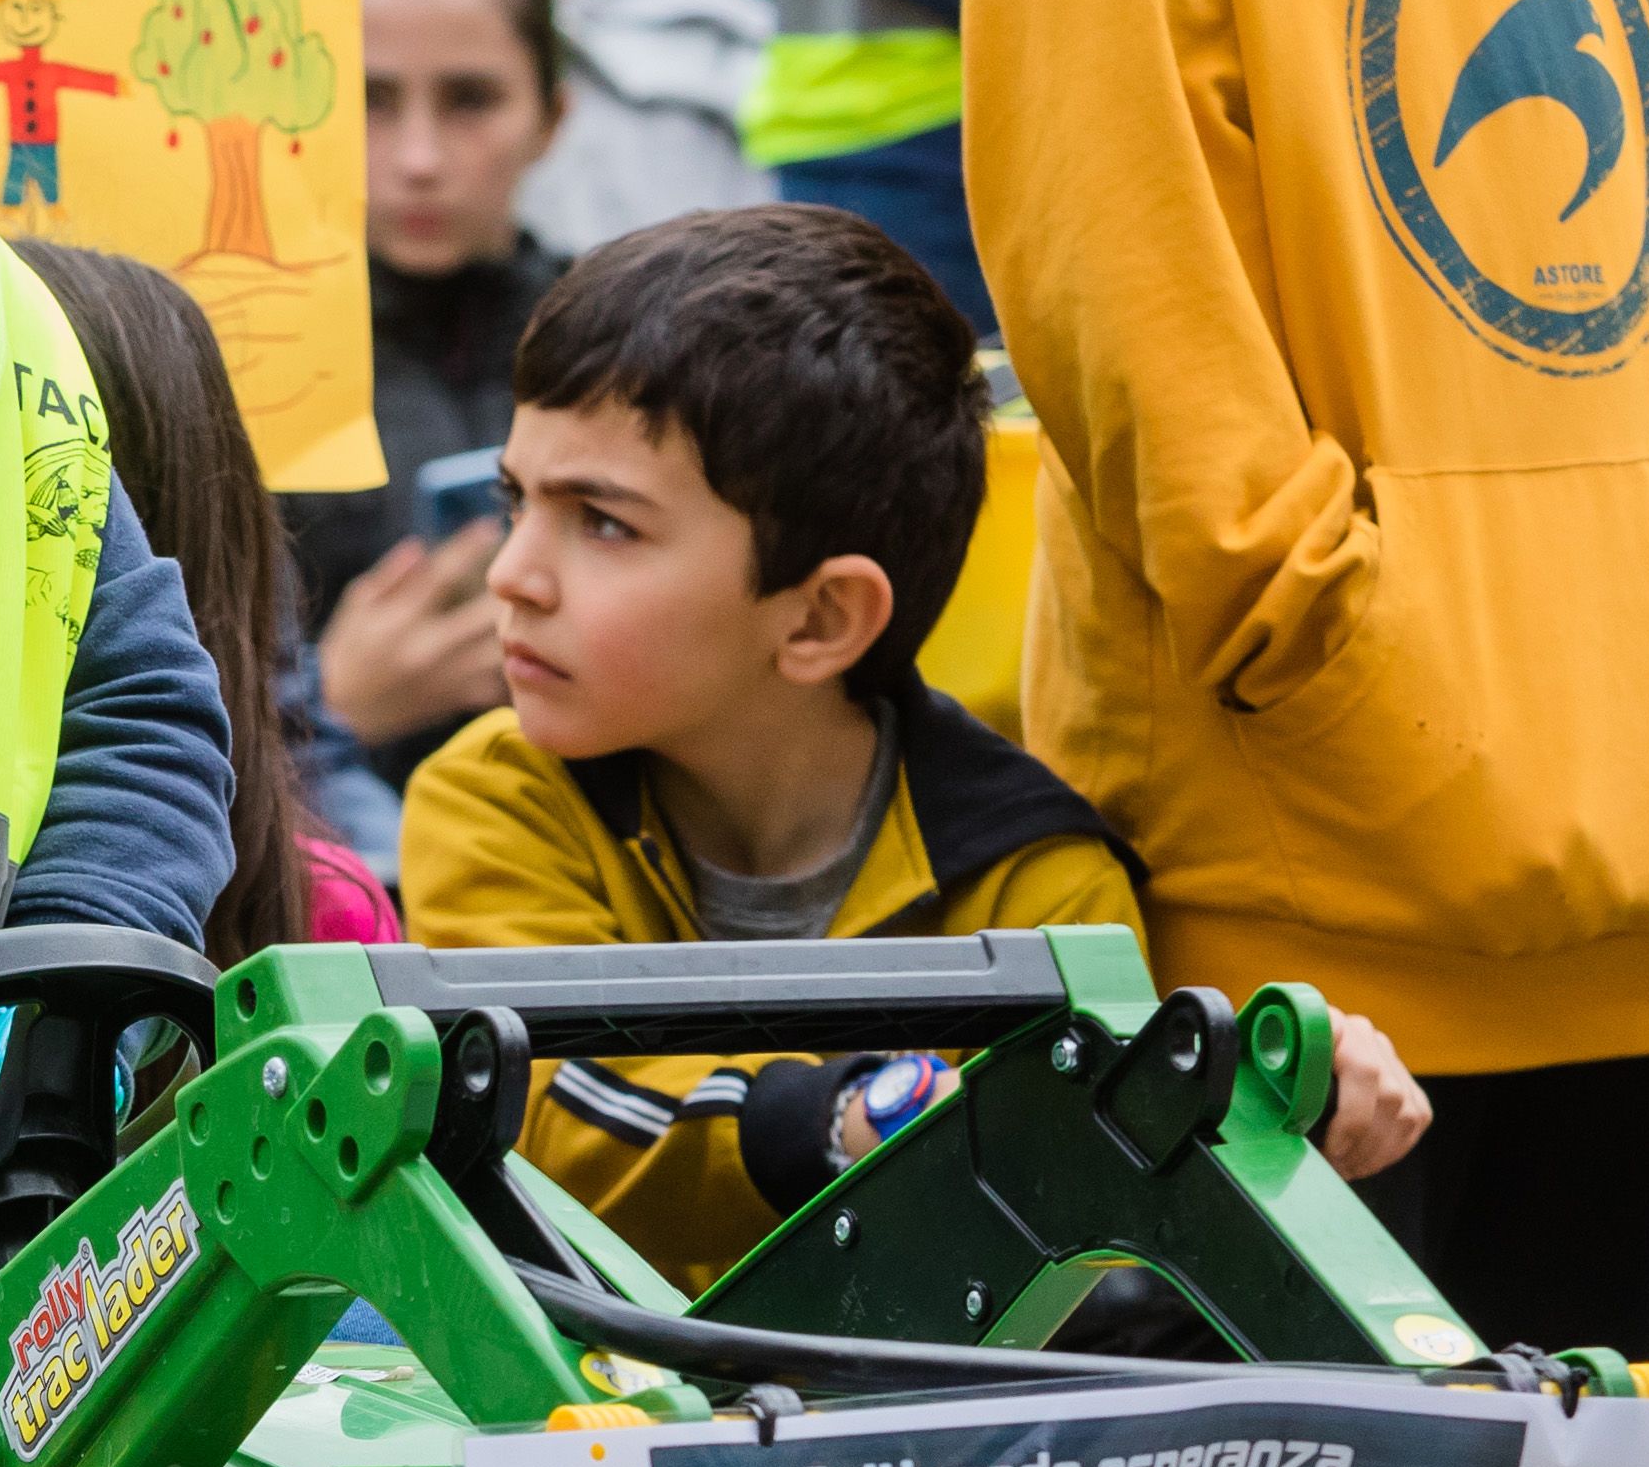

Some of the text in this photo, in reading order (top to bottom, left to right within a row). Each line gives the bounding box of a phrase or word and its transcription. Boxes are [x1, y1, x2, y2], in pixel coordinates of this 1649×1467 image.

[11, 1201, 188, 1444] trac lader
[15, 1266, 85, 1371] rolly
